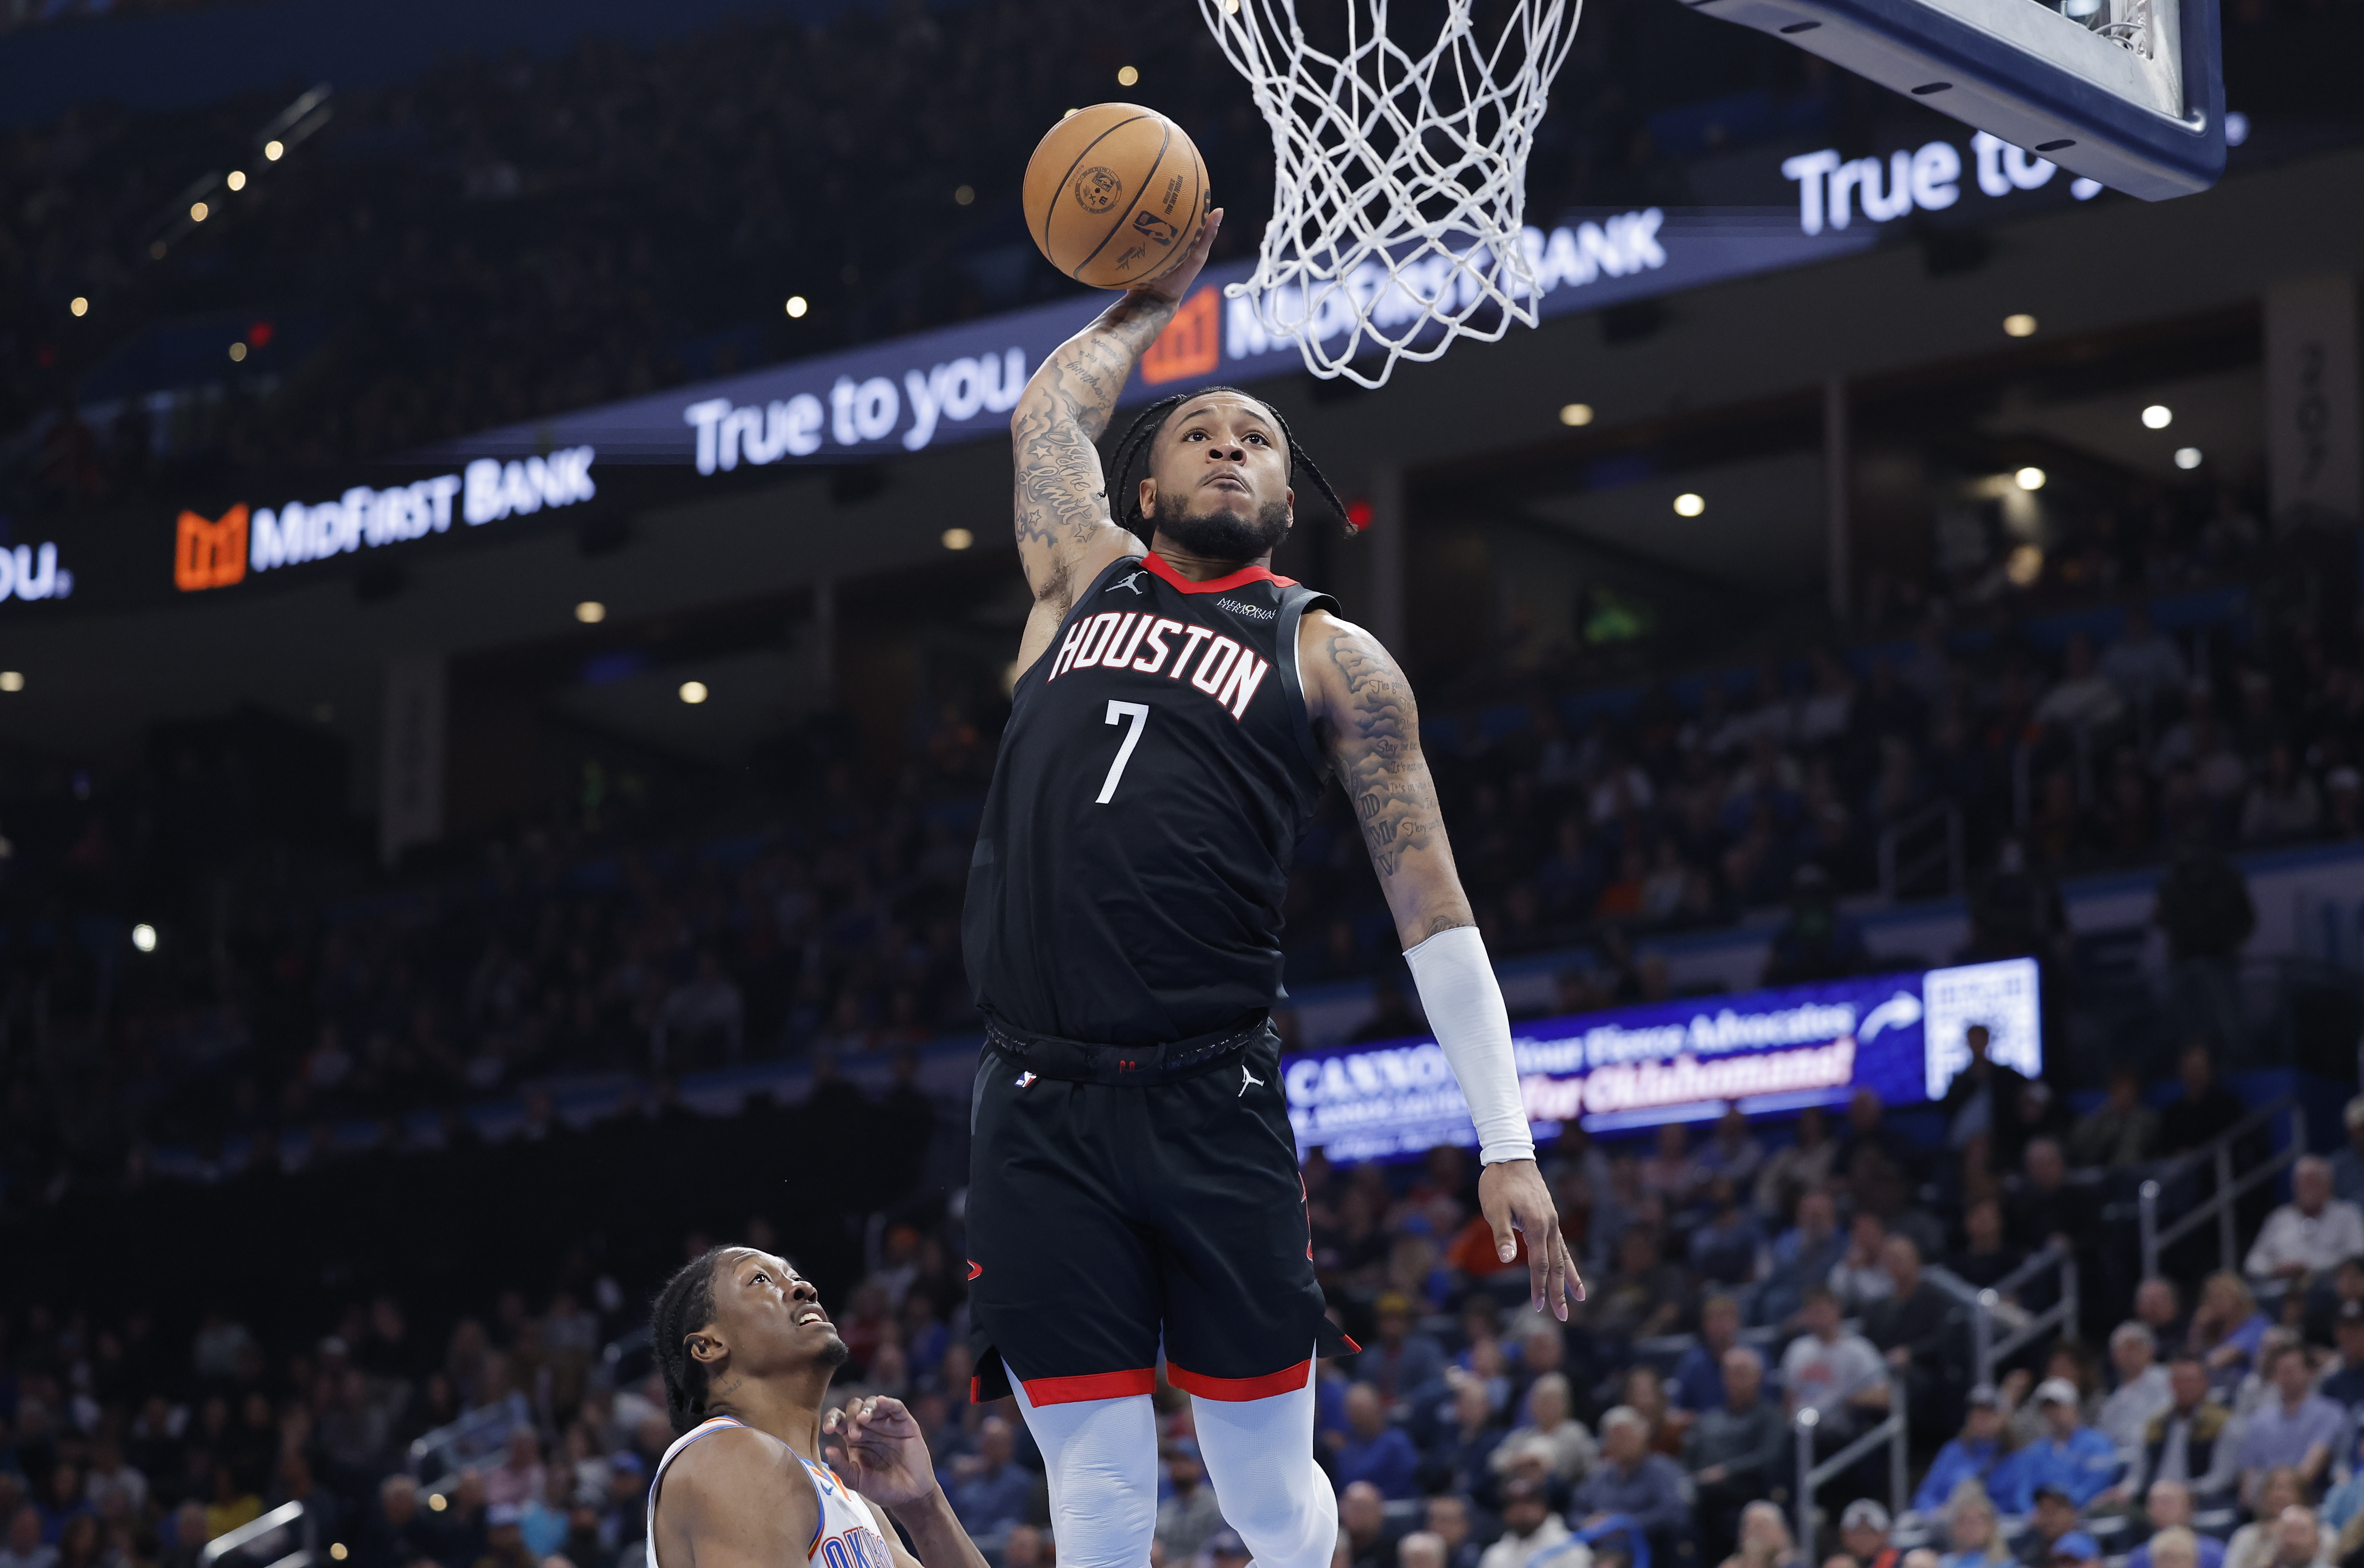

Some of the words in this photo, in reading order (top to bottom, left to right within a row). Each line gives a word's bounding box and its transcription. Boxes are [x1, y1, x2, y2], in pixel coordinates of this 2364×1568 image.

[1782, 145, 1960, 235] True
[684, 397, 824, 476] True
[830, 375, 900, 445] to
[463, 446, 594, 526] BANK
[1018, 466, 1092, 525] Limit
[1216, 603, 1275, 620] HERMANN
[1218, 597, 1277, 616] MEMORIAL
[1047, 611, 1272, 723] HOUSTON
[1095, 699, 1149, 804] 7
[1286, 1042, 1453, 1108] CANNO
